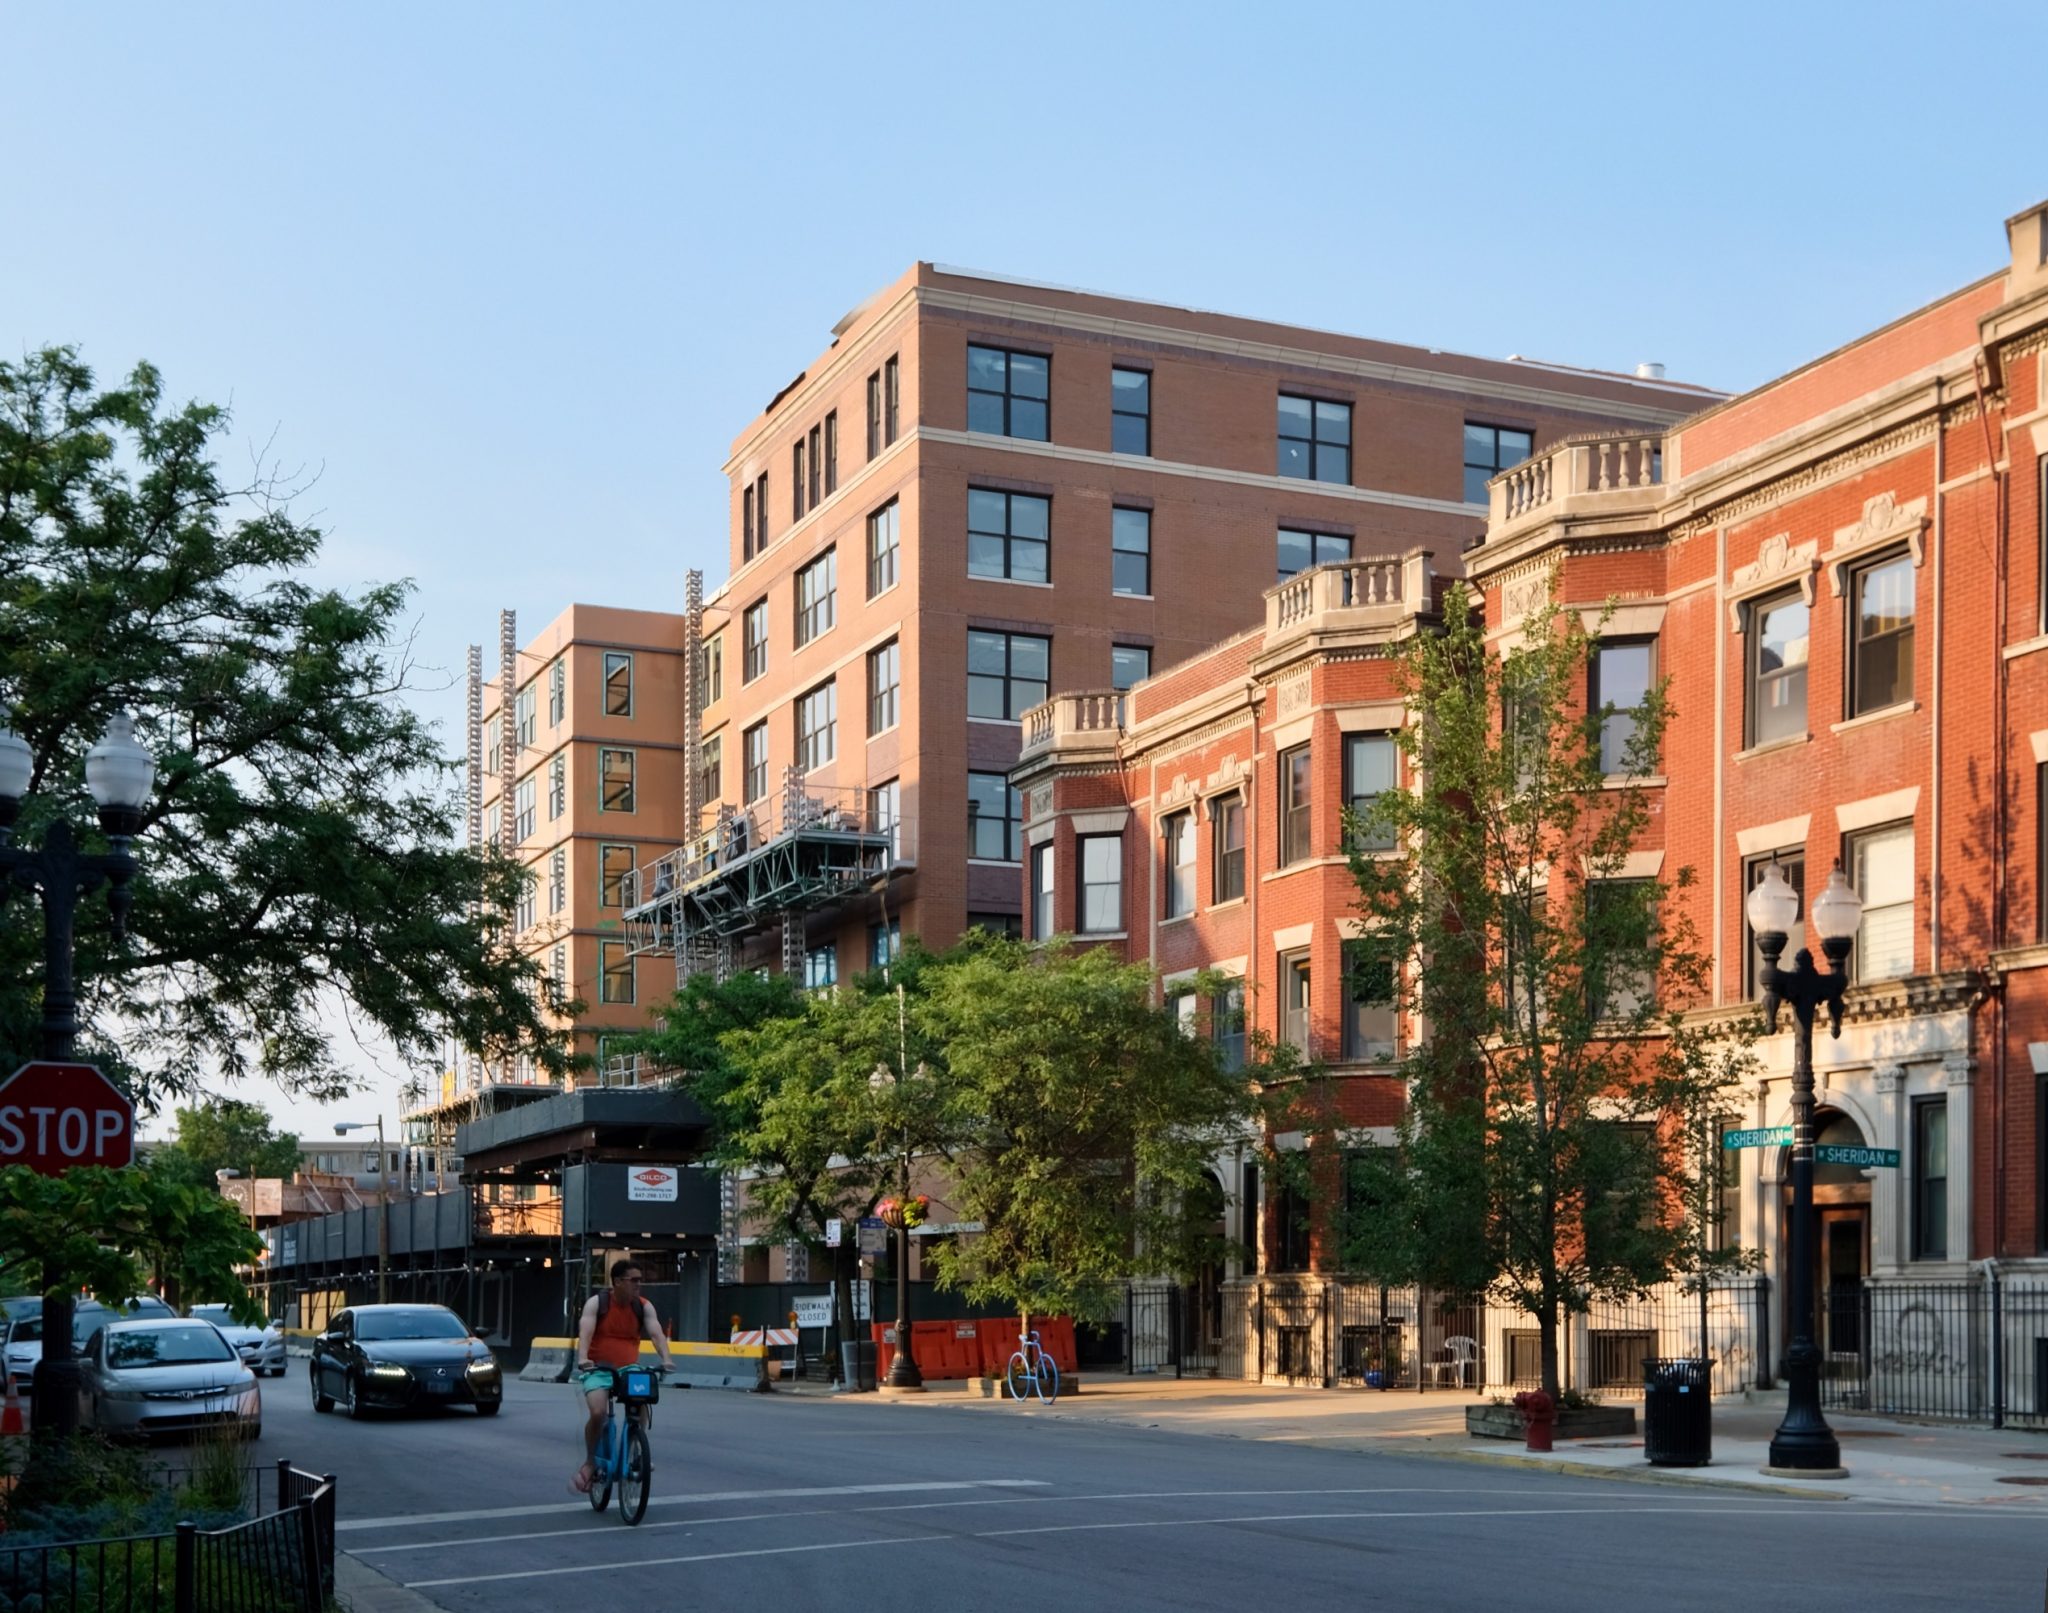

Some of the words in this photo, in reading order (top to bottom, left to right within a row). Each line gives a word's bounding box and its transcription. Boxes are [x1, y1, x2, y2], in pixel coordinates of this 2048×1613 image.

[0, 1105, 124, 1157] STOP
[1733, 1129, 1784, 1147] SHERIDAN
[1827, 1147, 1885, 1165] SHERIDAN
[795, 1302, 831, 1311] SIDEWALK
[798, 1312, 827, 1321] CLOSED
